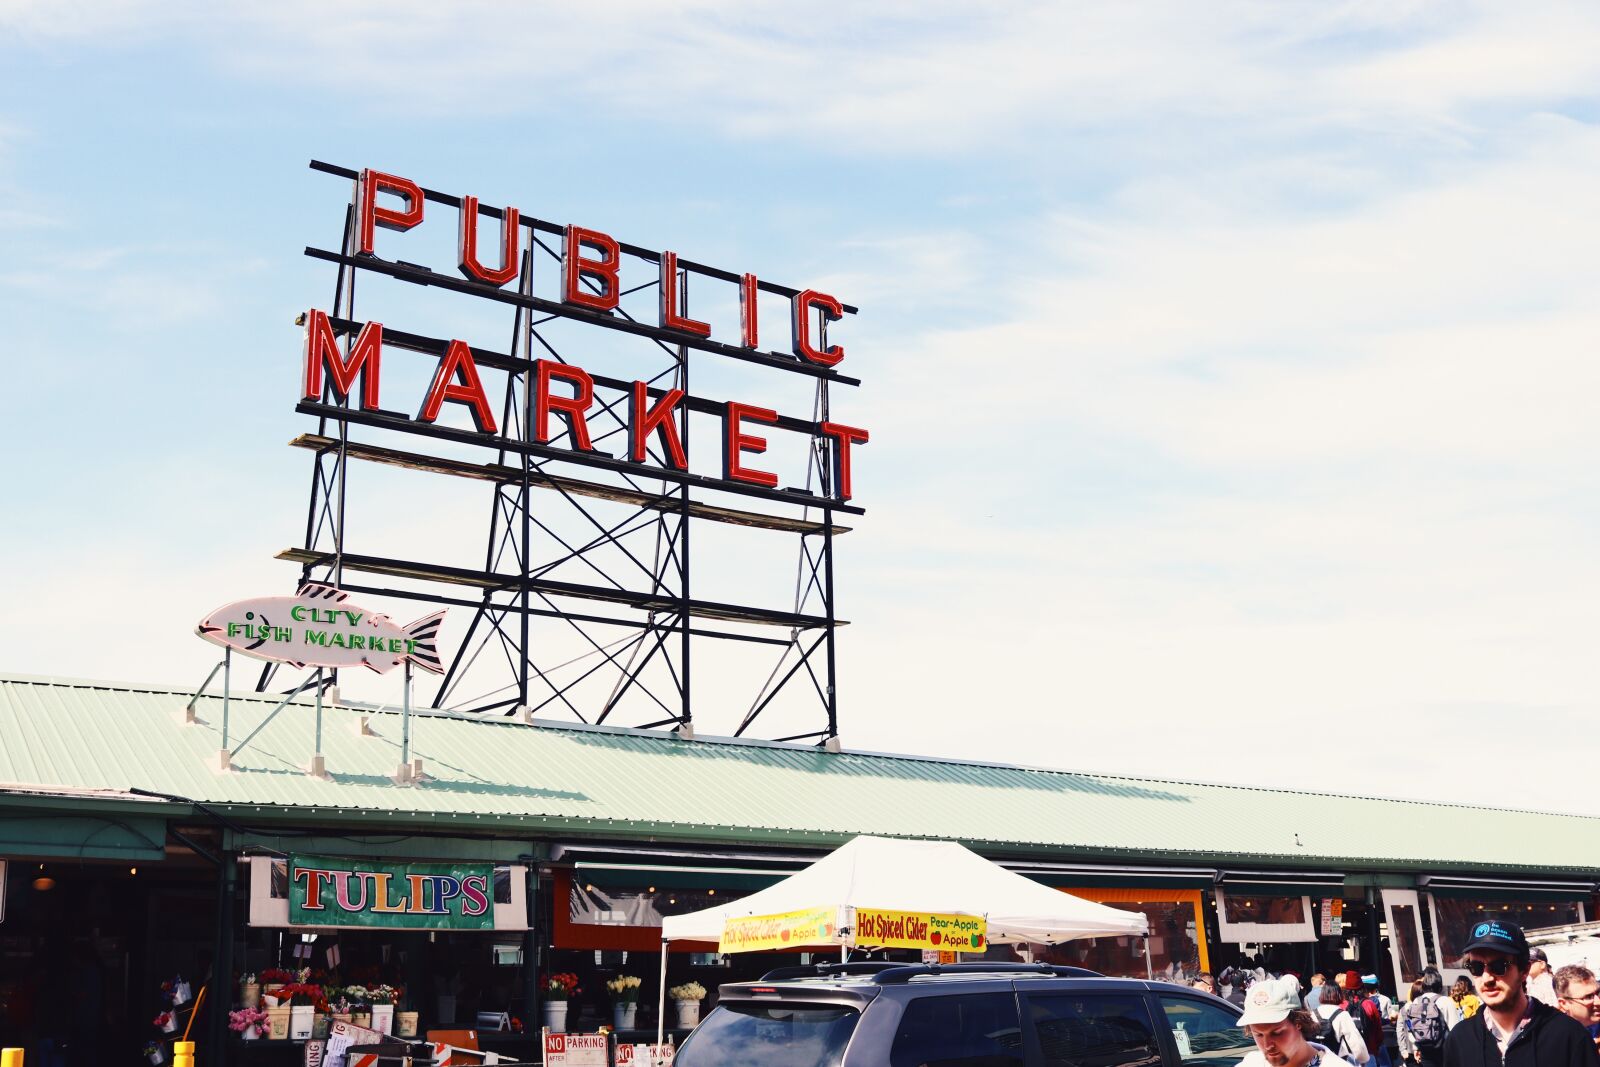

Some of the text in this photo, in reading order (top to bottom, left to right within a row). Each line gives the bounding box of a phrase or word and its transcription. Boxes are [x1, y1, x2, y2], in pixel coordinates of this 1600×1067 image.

[355, 168, 844, 368] PUBLIC
[301, 308, 869, 502] MARKET
[291, 605, 363, 627] CITY
[227, 622, 418, 655] FISH MARKET
[294, 867, 489, 916] TULIPS
[793, 928, 817, 940] Apple
[858, 913, 928, 943] Hot Spiced Cider
[930, 916, 978, 932] Pear-Apple
[943, 934, 969, 947] Apple
[548, 1037, 604, 1050] NO PARKING
[618, 1047, 632, 1060] NO
